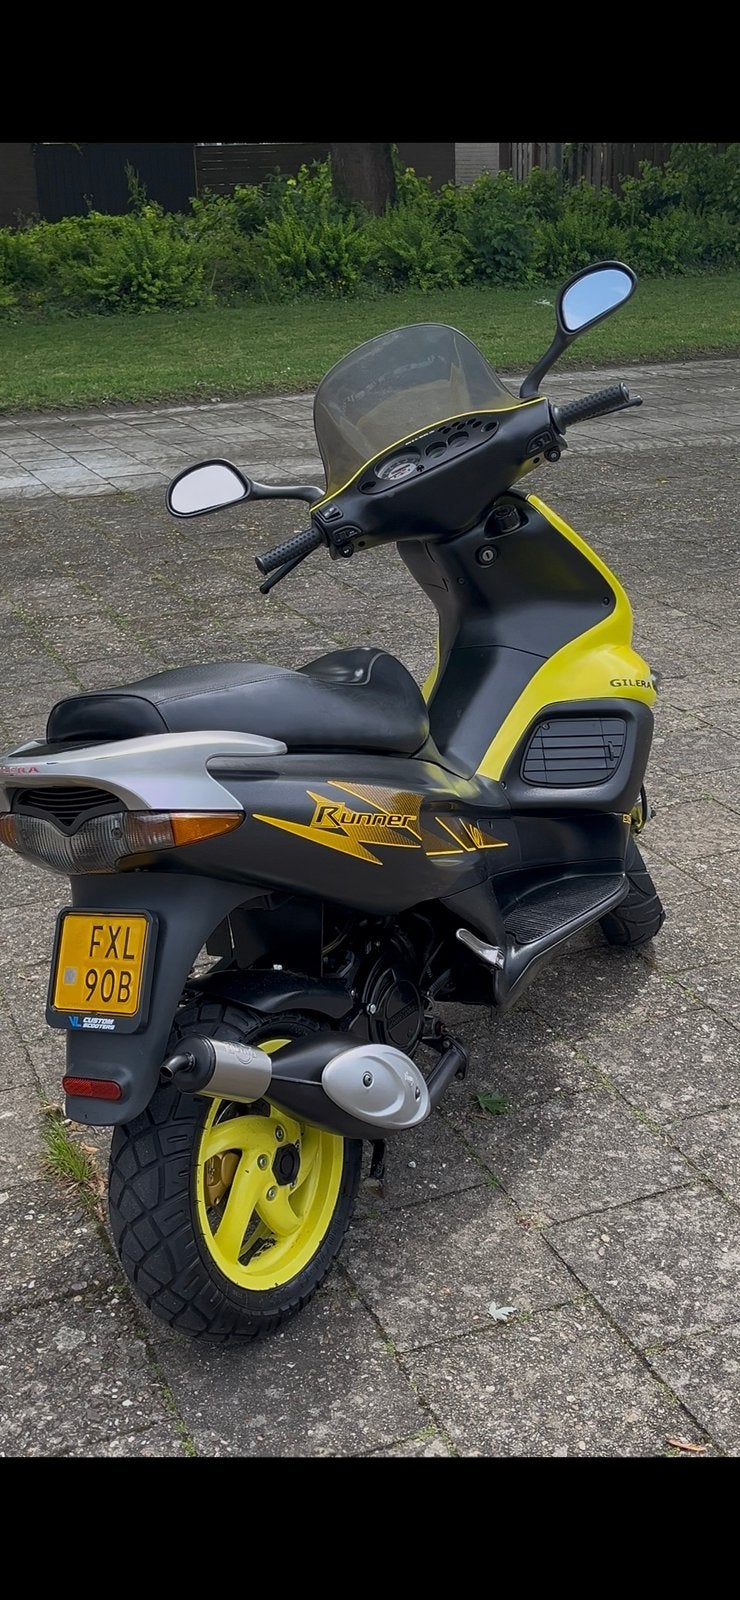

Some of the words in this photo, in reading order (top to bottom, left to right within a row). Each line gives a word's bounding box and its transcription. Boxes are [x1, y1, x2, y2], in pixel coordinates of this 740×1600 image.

[609, 678, 652, 689] GILERA
[89, 925, 135, 960] FXL
[85, 968, 132, 1003] 90B
[82, 1016, 115, 1025] CUSTOM
[82, 1022, 116, 1030] SCOOTERS
